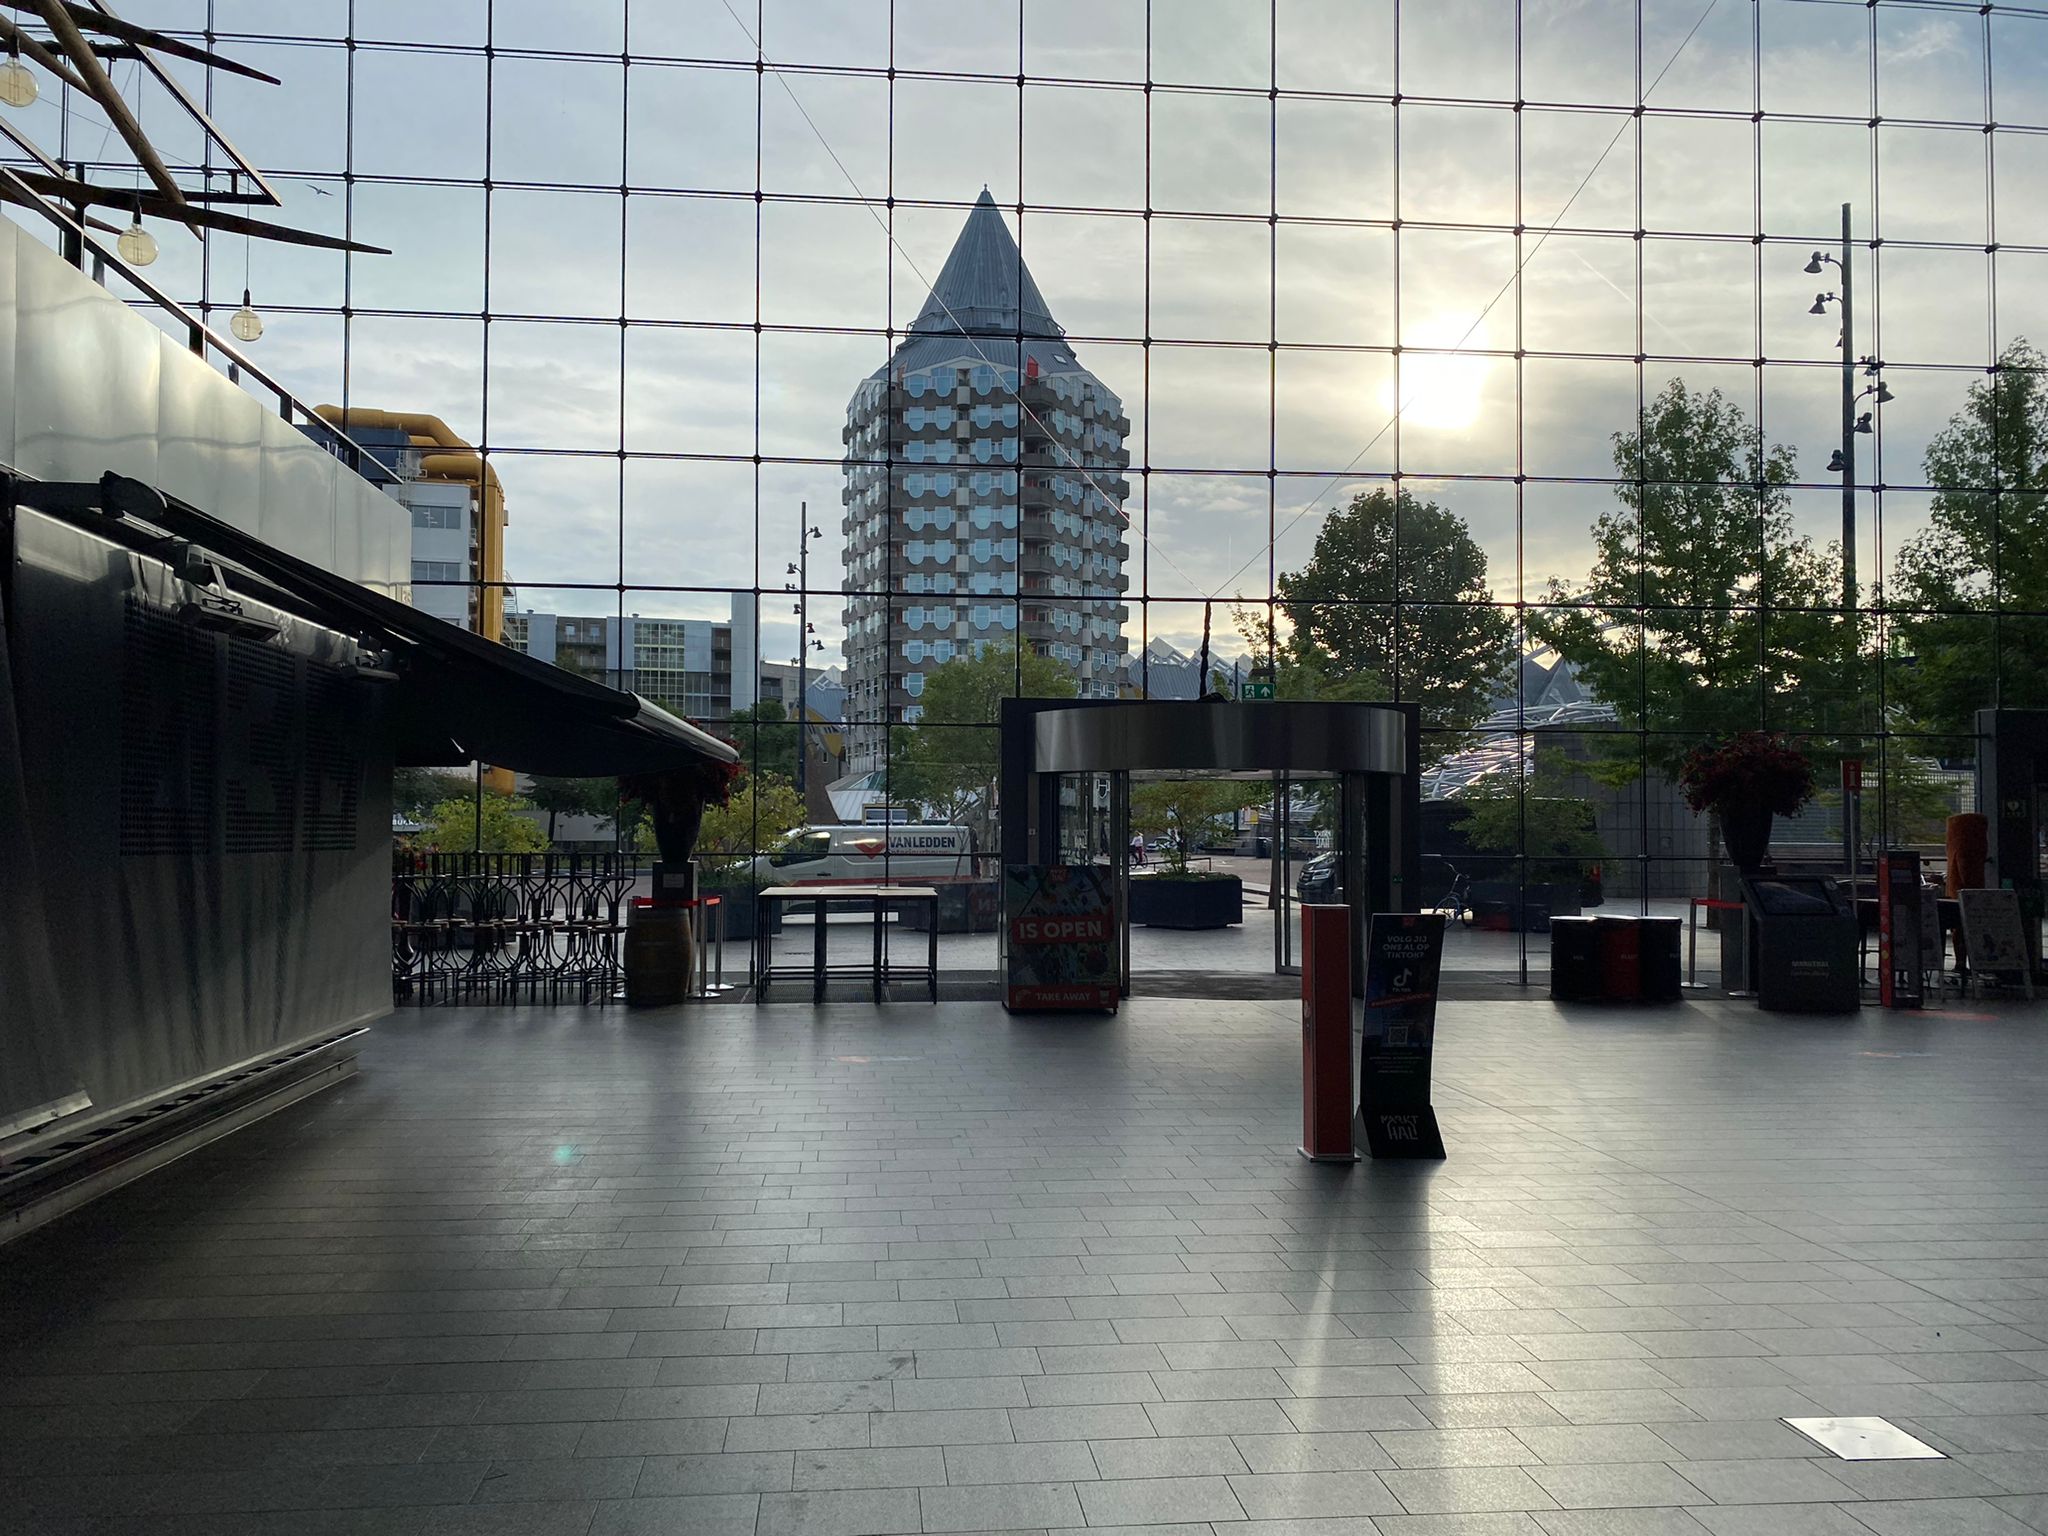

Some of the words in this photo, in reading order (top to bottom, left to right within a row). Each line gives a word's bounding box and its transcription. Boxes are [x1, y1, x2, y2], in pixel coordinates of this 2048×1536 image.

[1020, 922, 1038, 939] IS
[1043, 920, 1102, 938] OPEN
[1387, 935, 1412, 943] VOLG
[1413, 935, 1428, 943] JIJ
[1416, 944, 1431, 952] OP
[1035, 992, 1061, 1001] TAKE
[1063, 991, 1091, 1001] AWAY
